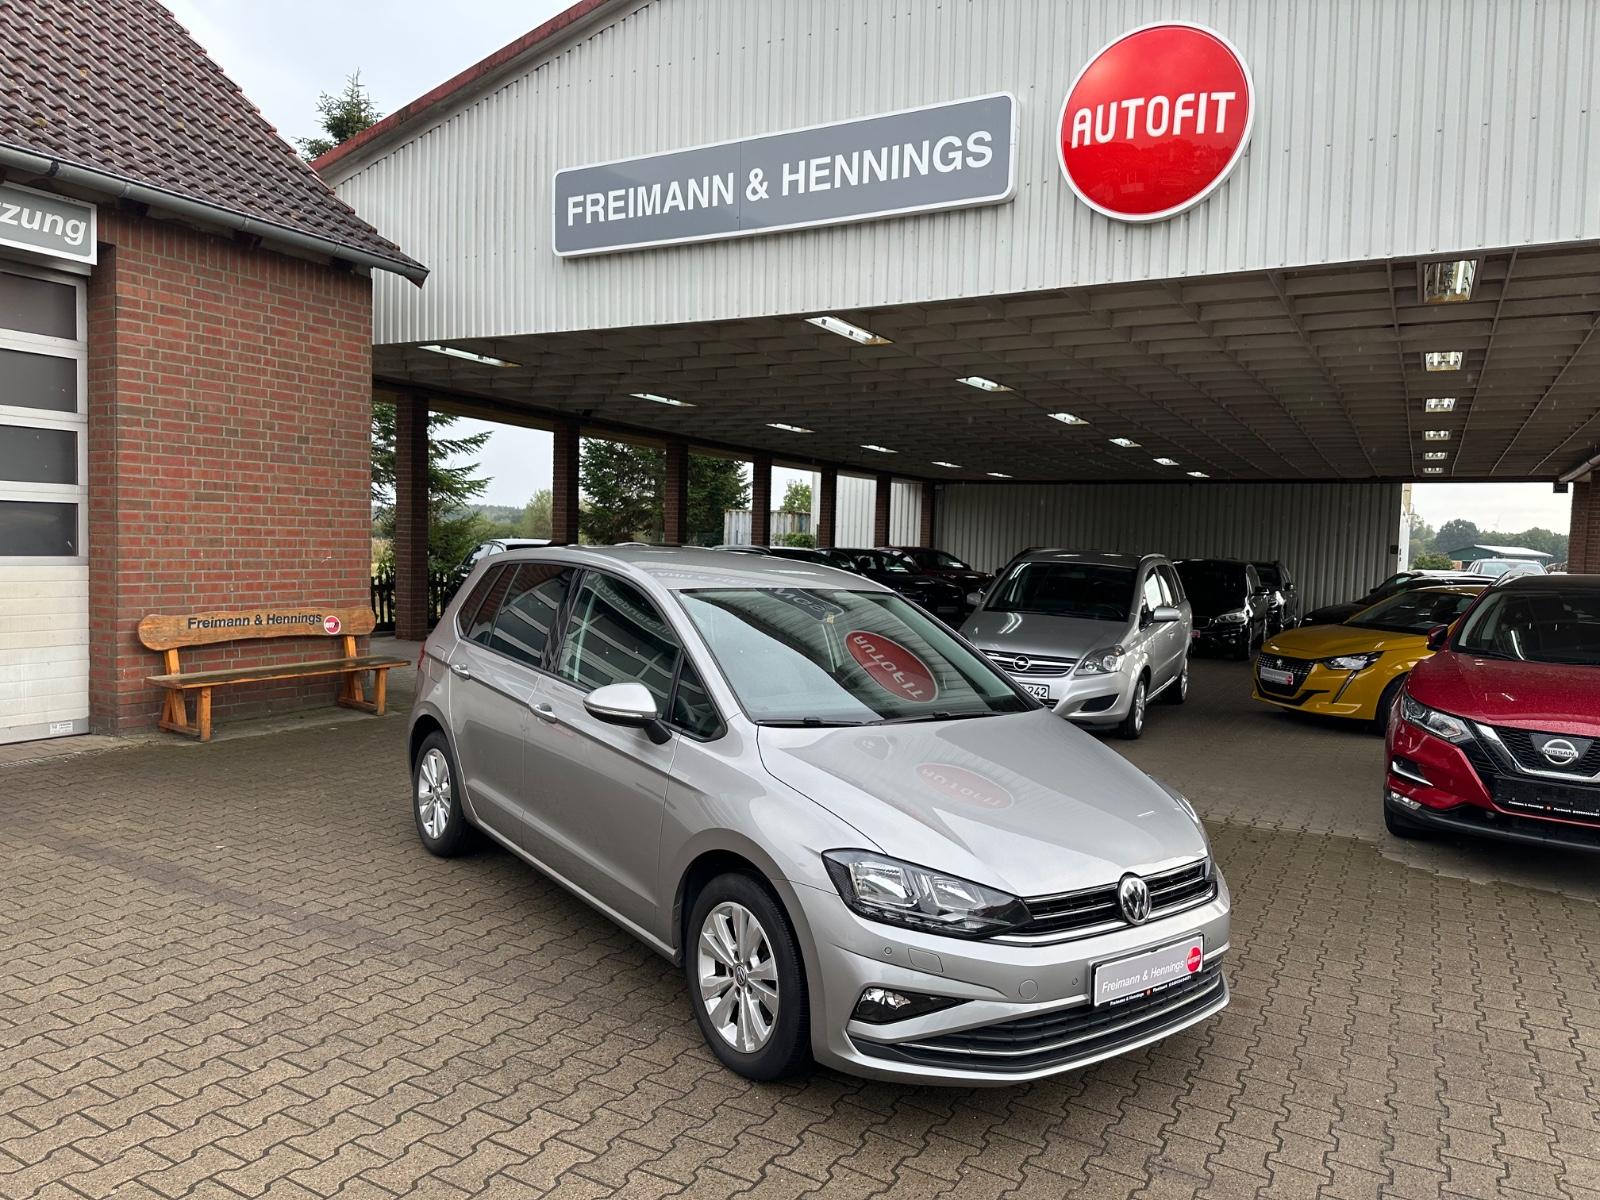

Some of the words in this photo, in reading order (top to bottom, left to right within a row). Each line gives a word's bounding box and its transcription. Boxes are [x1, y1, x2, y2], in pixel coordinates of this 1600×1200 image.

[1071, 91, 1236, 149] AUTOFIT
[567, 172, 735, 226] FREIMANN
[745, 168, 769, 201] &
[781, 130, 993, 197] HENNINGS
[0, 201, 87, 245] zung
[187, 617, 250, 629] Freimann
[254, 614, 263, 625] &
[266, 613, 322, 626] Hennings
[1543, 747, 1576, 757] NISSAN
[1102, 974, 1140, 993] Freimann
[1142, 970, 1149, 981] &
[1150, 960, 1185, 979] Hennings
